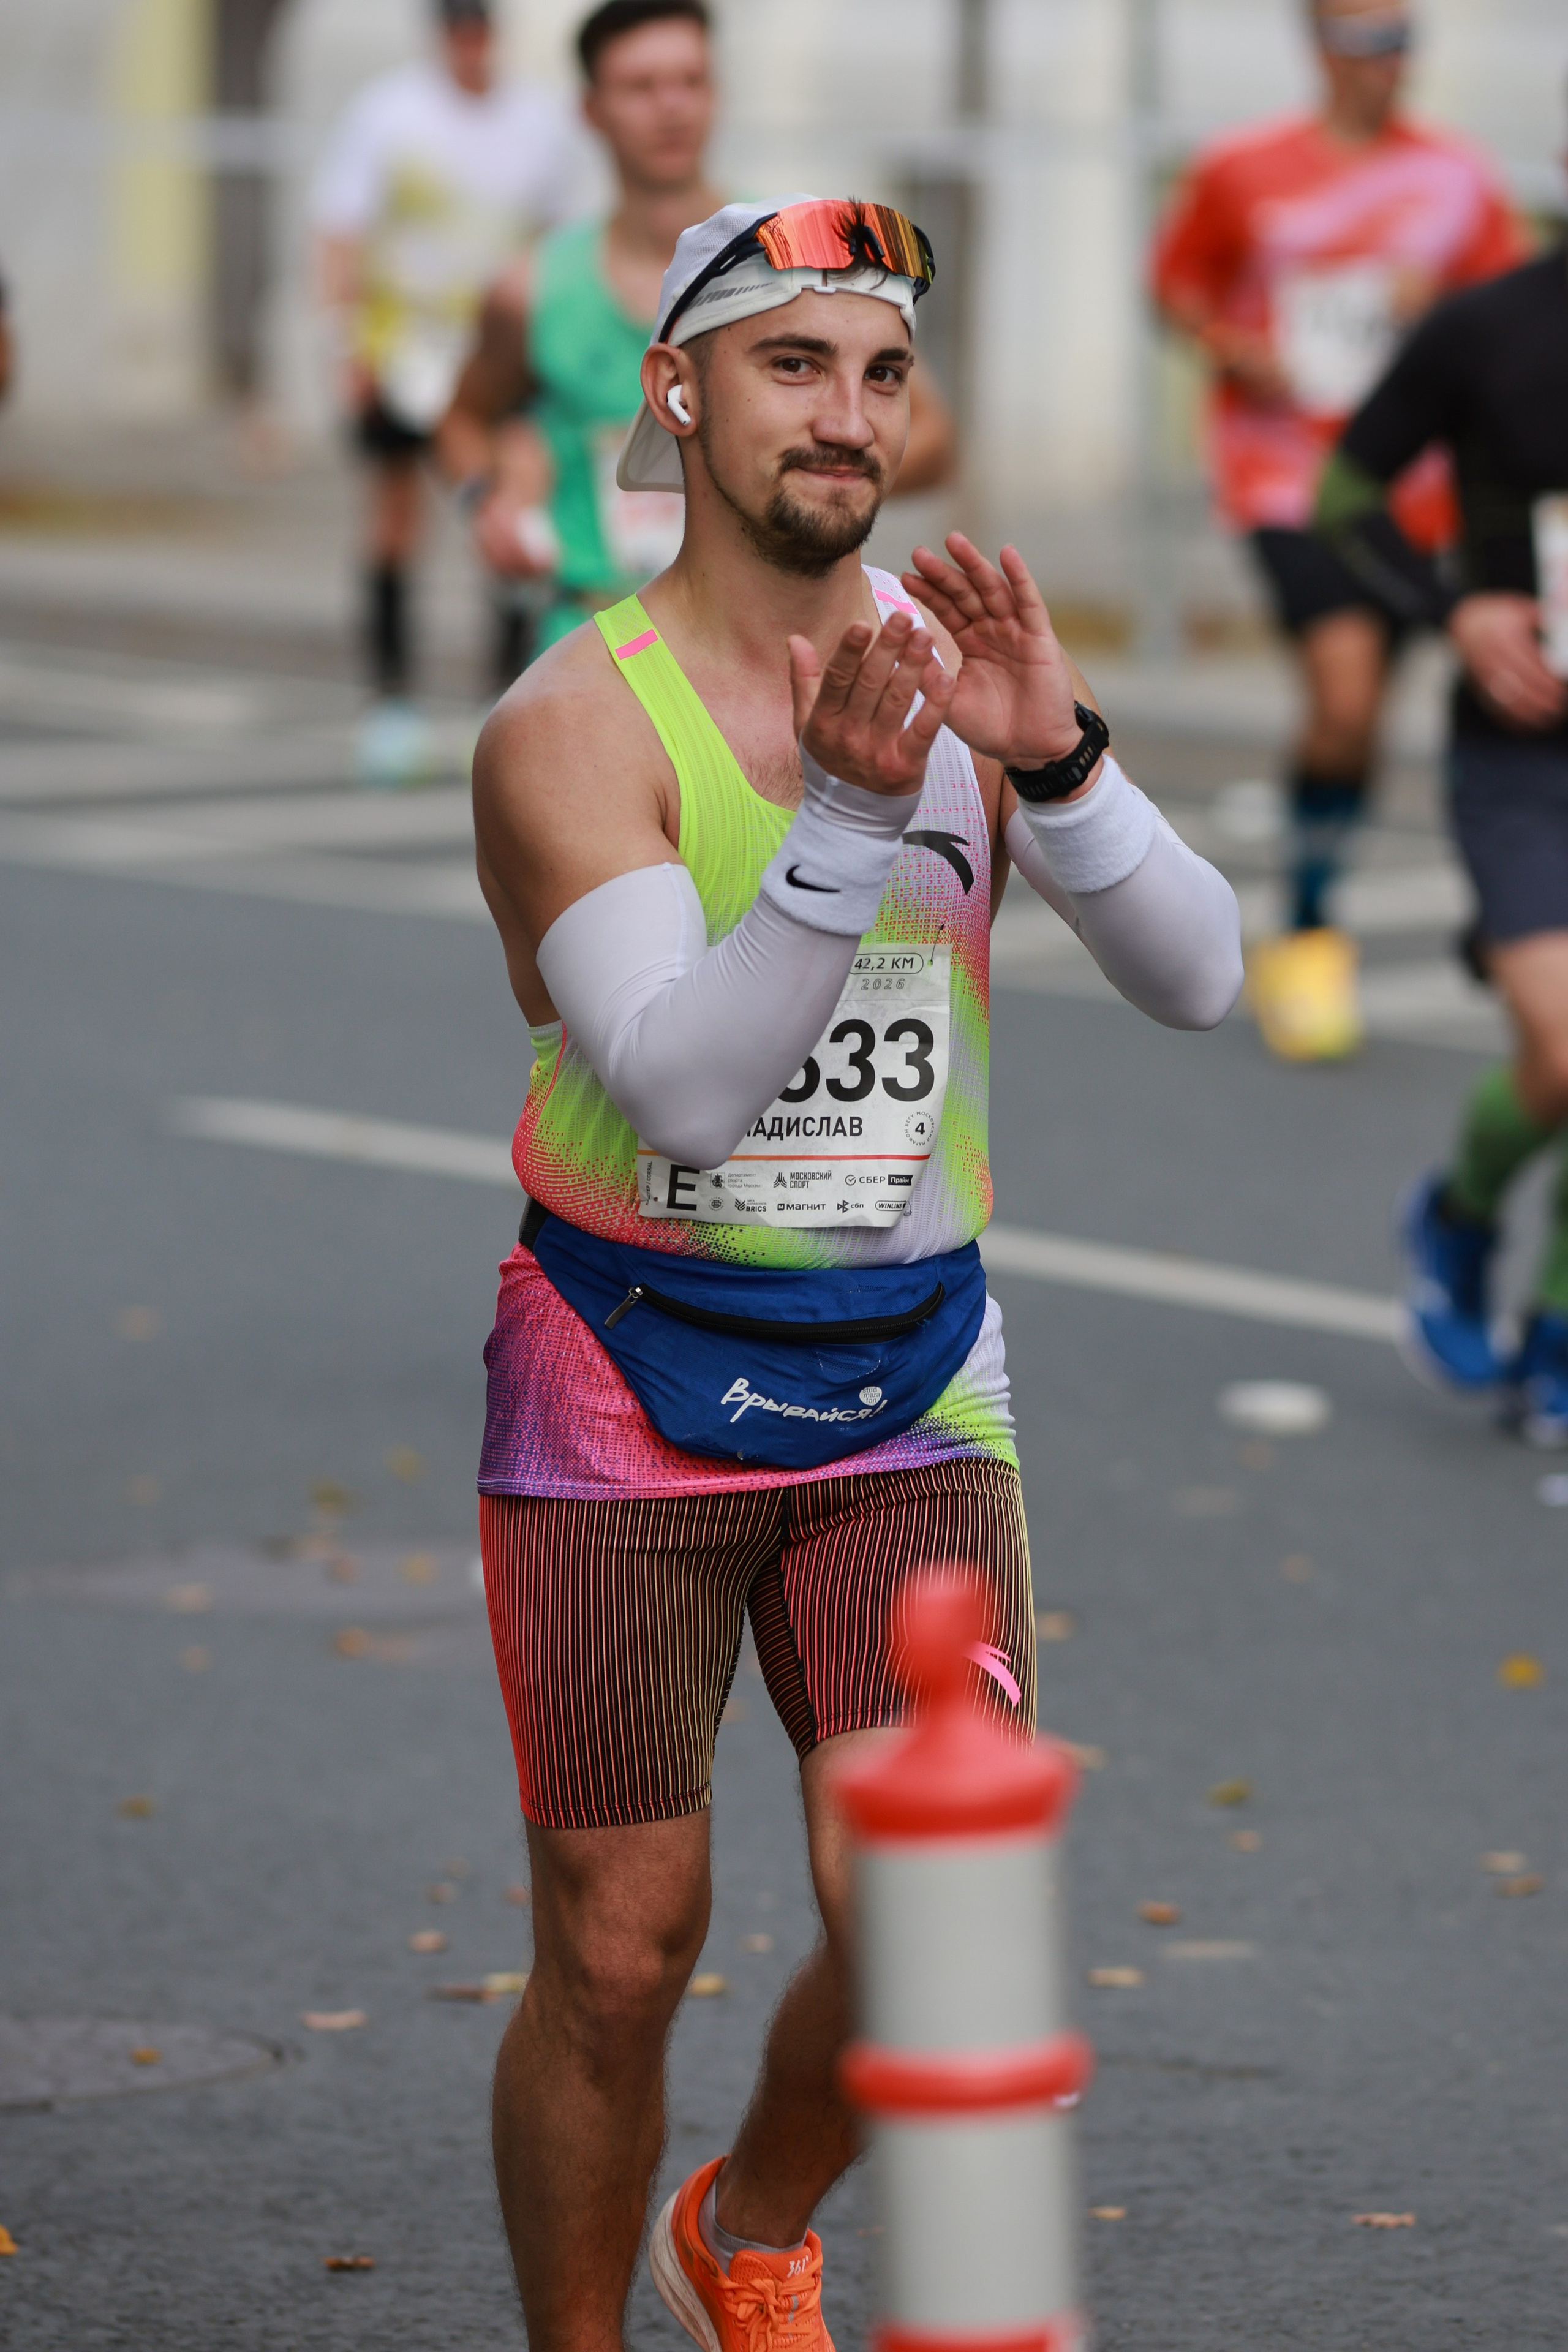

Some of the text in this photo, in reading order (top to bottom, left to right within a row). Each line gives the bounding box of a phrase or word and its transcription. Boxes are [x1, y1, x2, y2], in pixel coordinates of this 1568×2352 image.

[854, 957, 885, 971] 42,2
[861, 978, 905, 990] 2026
[915, 1122, 925, 1135] 4
[790, 1170, 832, 1180] МОСКОВСКИЙ
